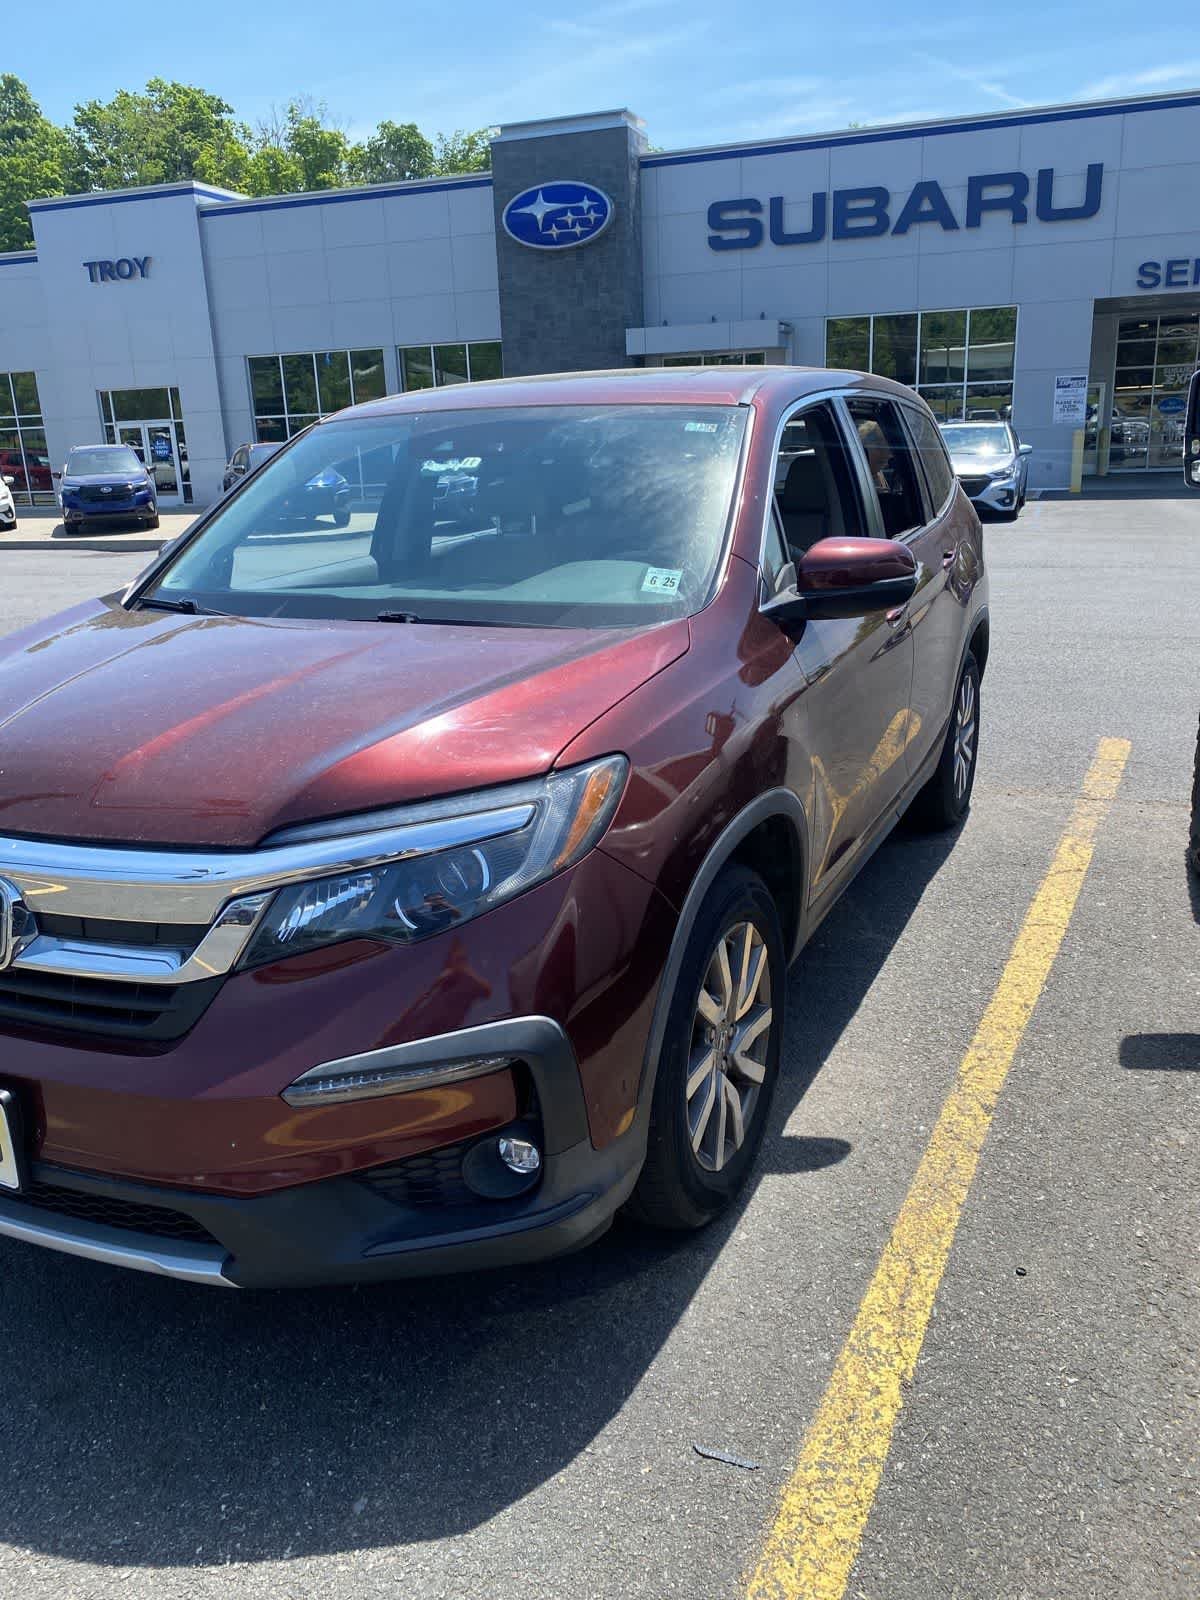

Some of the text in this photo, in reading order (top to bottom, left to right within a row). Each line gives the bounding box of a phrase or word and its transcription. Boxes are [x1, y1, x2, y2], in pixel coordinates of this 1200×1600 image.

[707, 162, 1104, 251] SUBARU
[83, 256, 153, 284] TROY
[662, 576, 677, 588] 25
